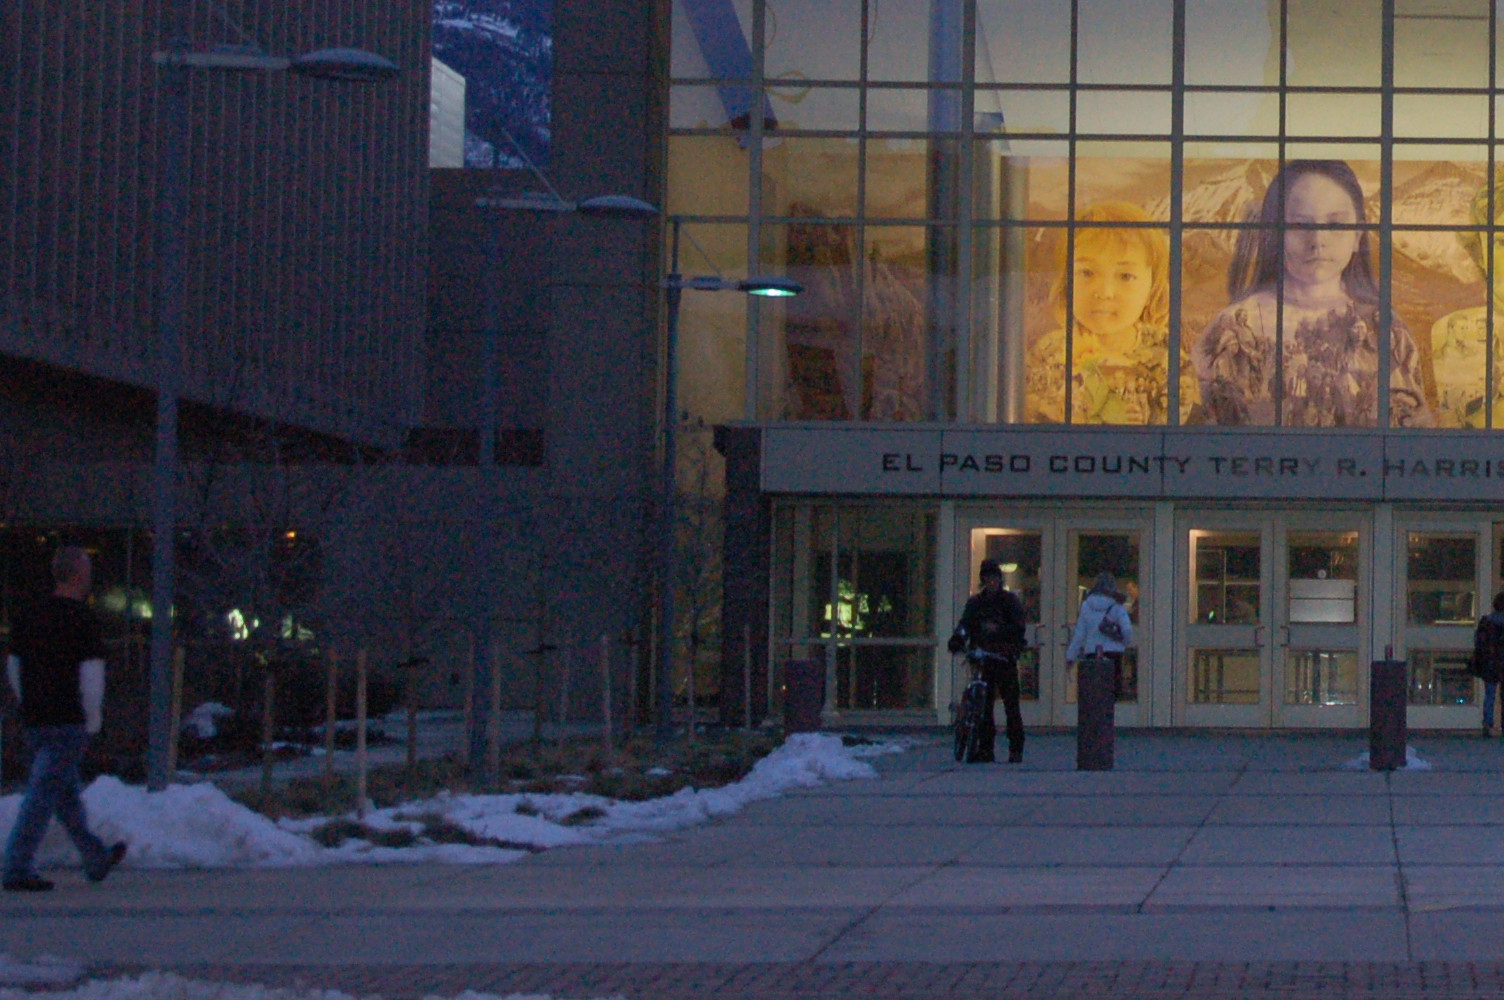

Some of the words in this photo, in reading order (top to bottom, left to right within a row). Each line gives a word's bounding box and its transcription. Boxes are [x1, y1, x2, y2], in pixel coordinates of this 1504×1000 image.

[882, 453, 923, 472] EL
[941, 453, 1031, 472] PASO
[1049, 454, 1190, 474] COUNTY
[1209, 457, 1321, 476] TERRY
[1337, 457, 1367, 477] R.
